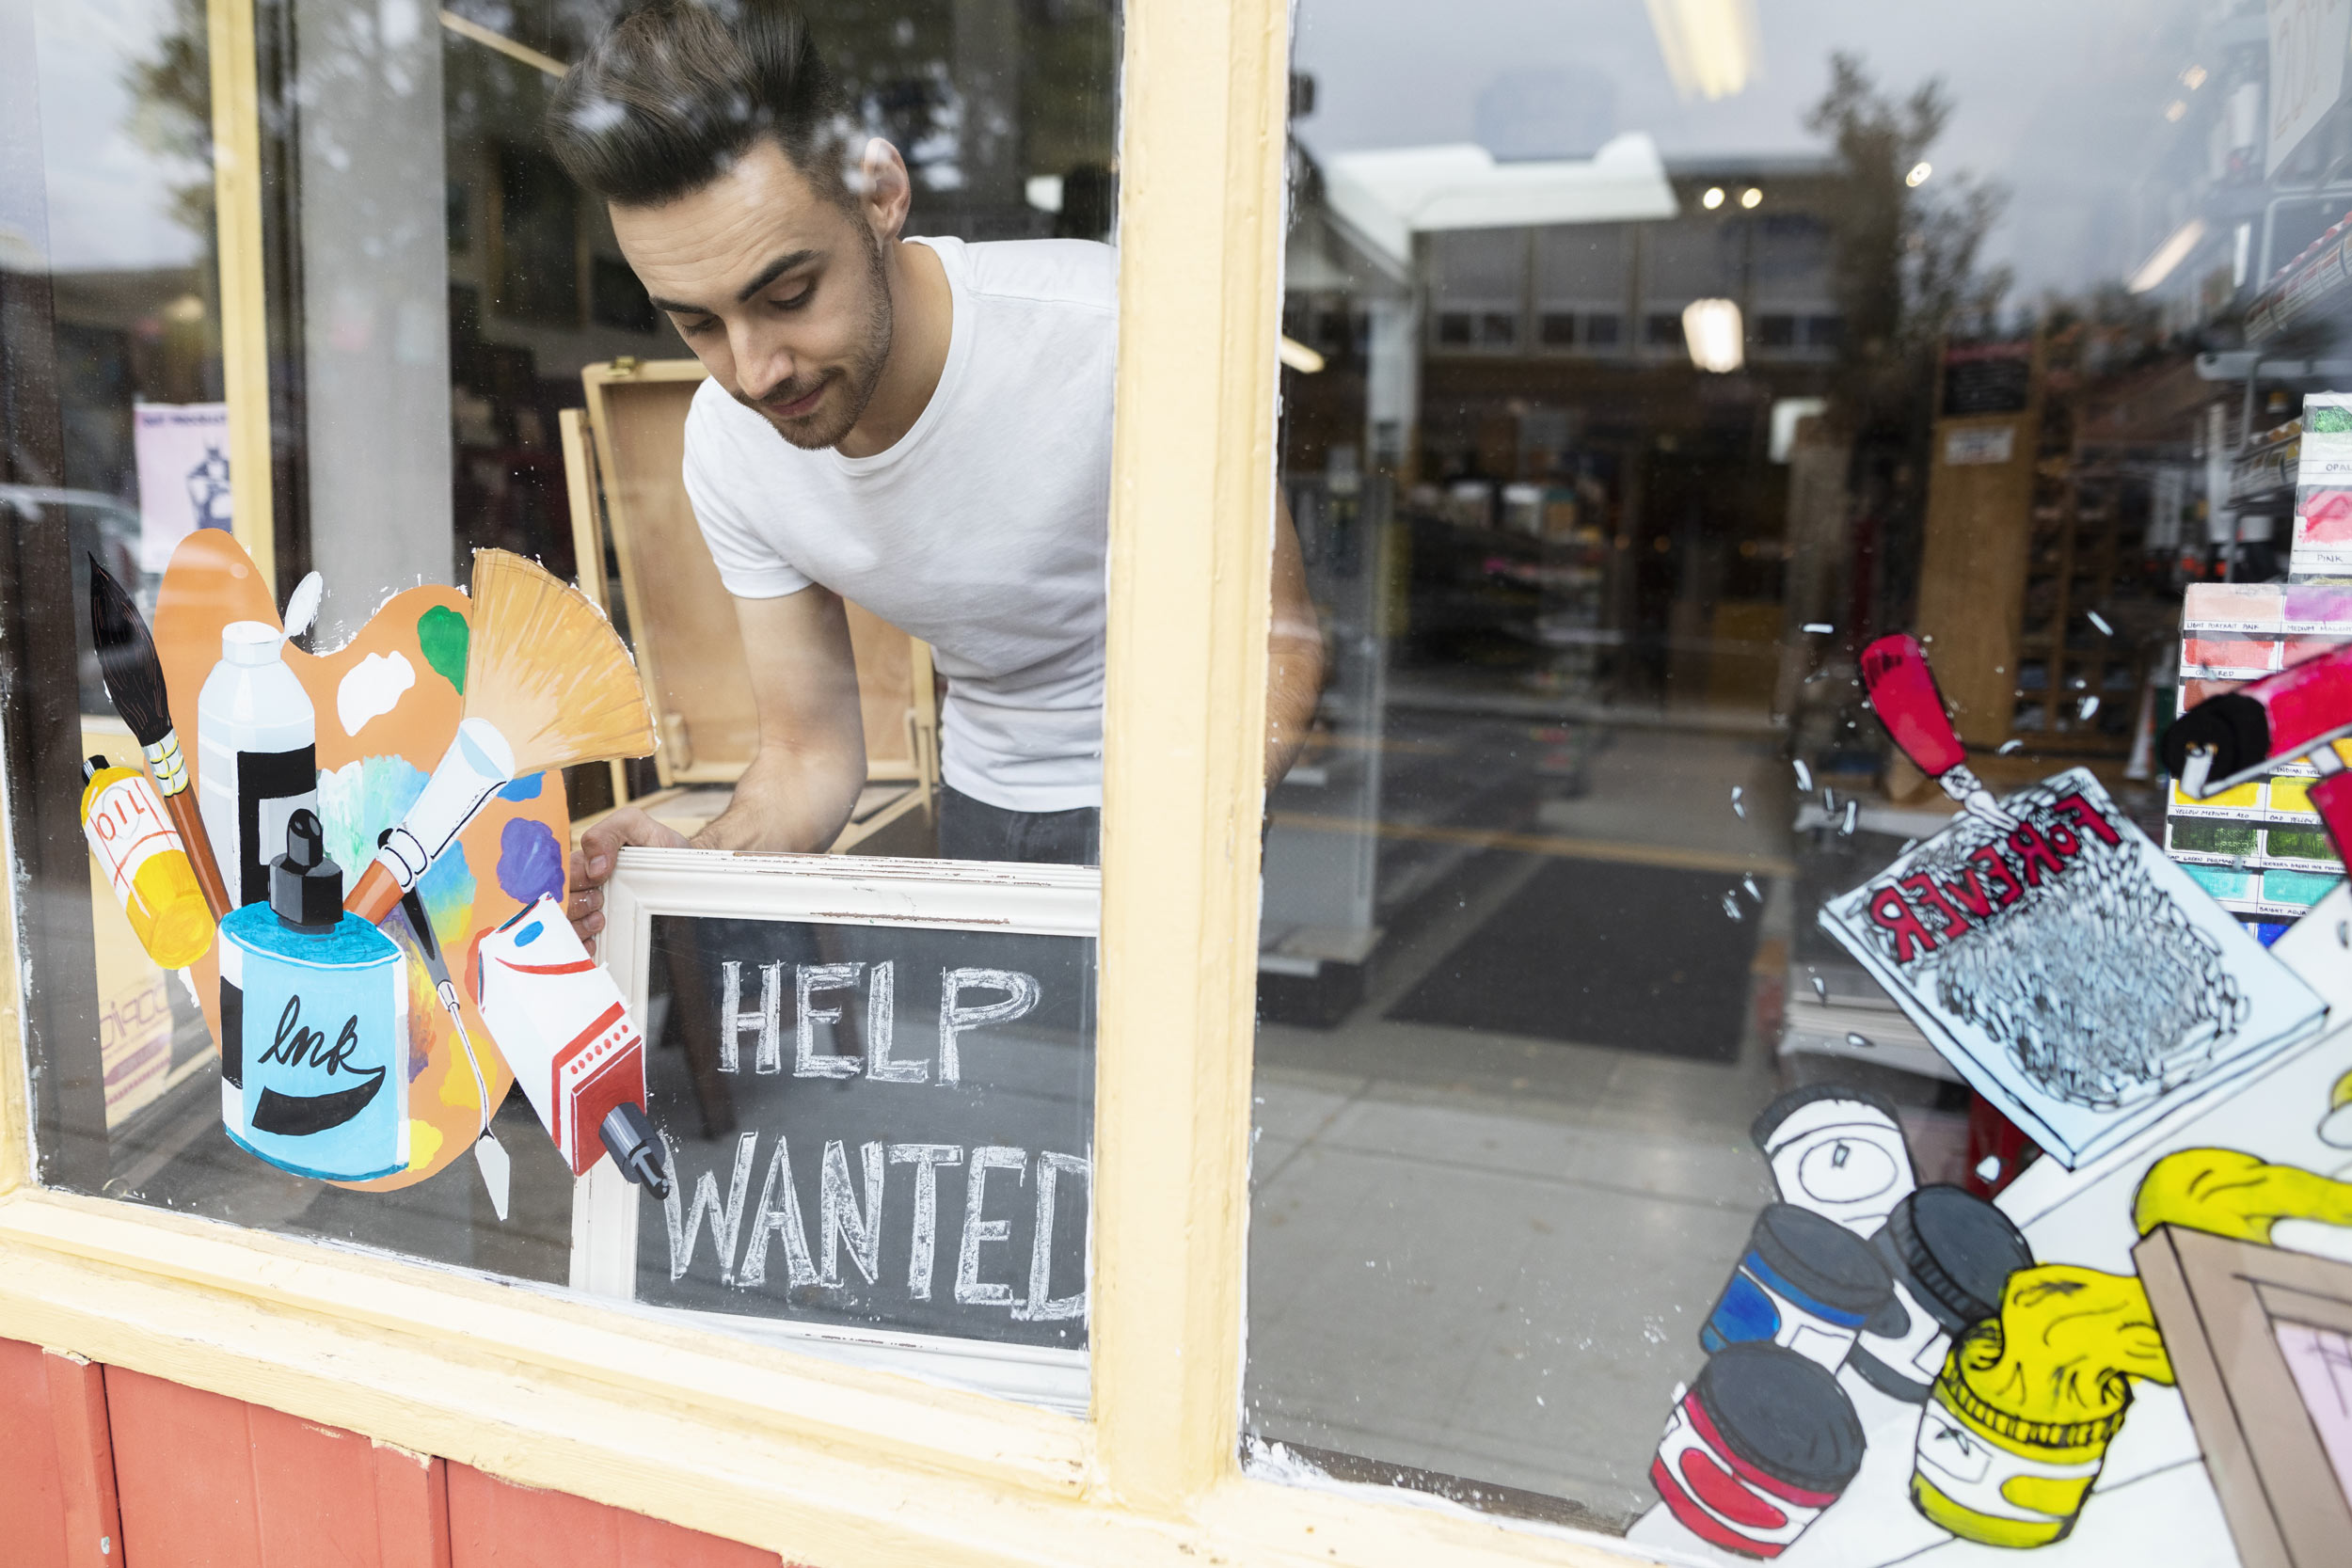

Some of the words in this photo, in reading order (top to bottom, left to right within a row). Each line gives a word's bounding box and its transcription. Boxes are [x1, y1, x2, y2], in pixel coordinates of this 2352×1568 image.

[2317, 553, 2343, 562] PINK
[2287, 625, 2315, 633] MEDIUM
[2276, 767, 2302, 775] INDIAN
[96, 789, 146, 842] OIL
[2175, 807, 2200, 816] YELLOW
[2259, 906, 2283, 914] BRIGHT
[718, 959, 1042, 1086] HELP
[257, 993, 386, 1077] Ink
[659, 1130, 1092, 1322] WANTED
